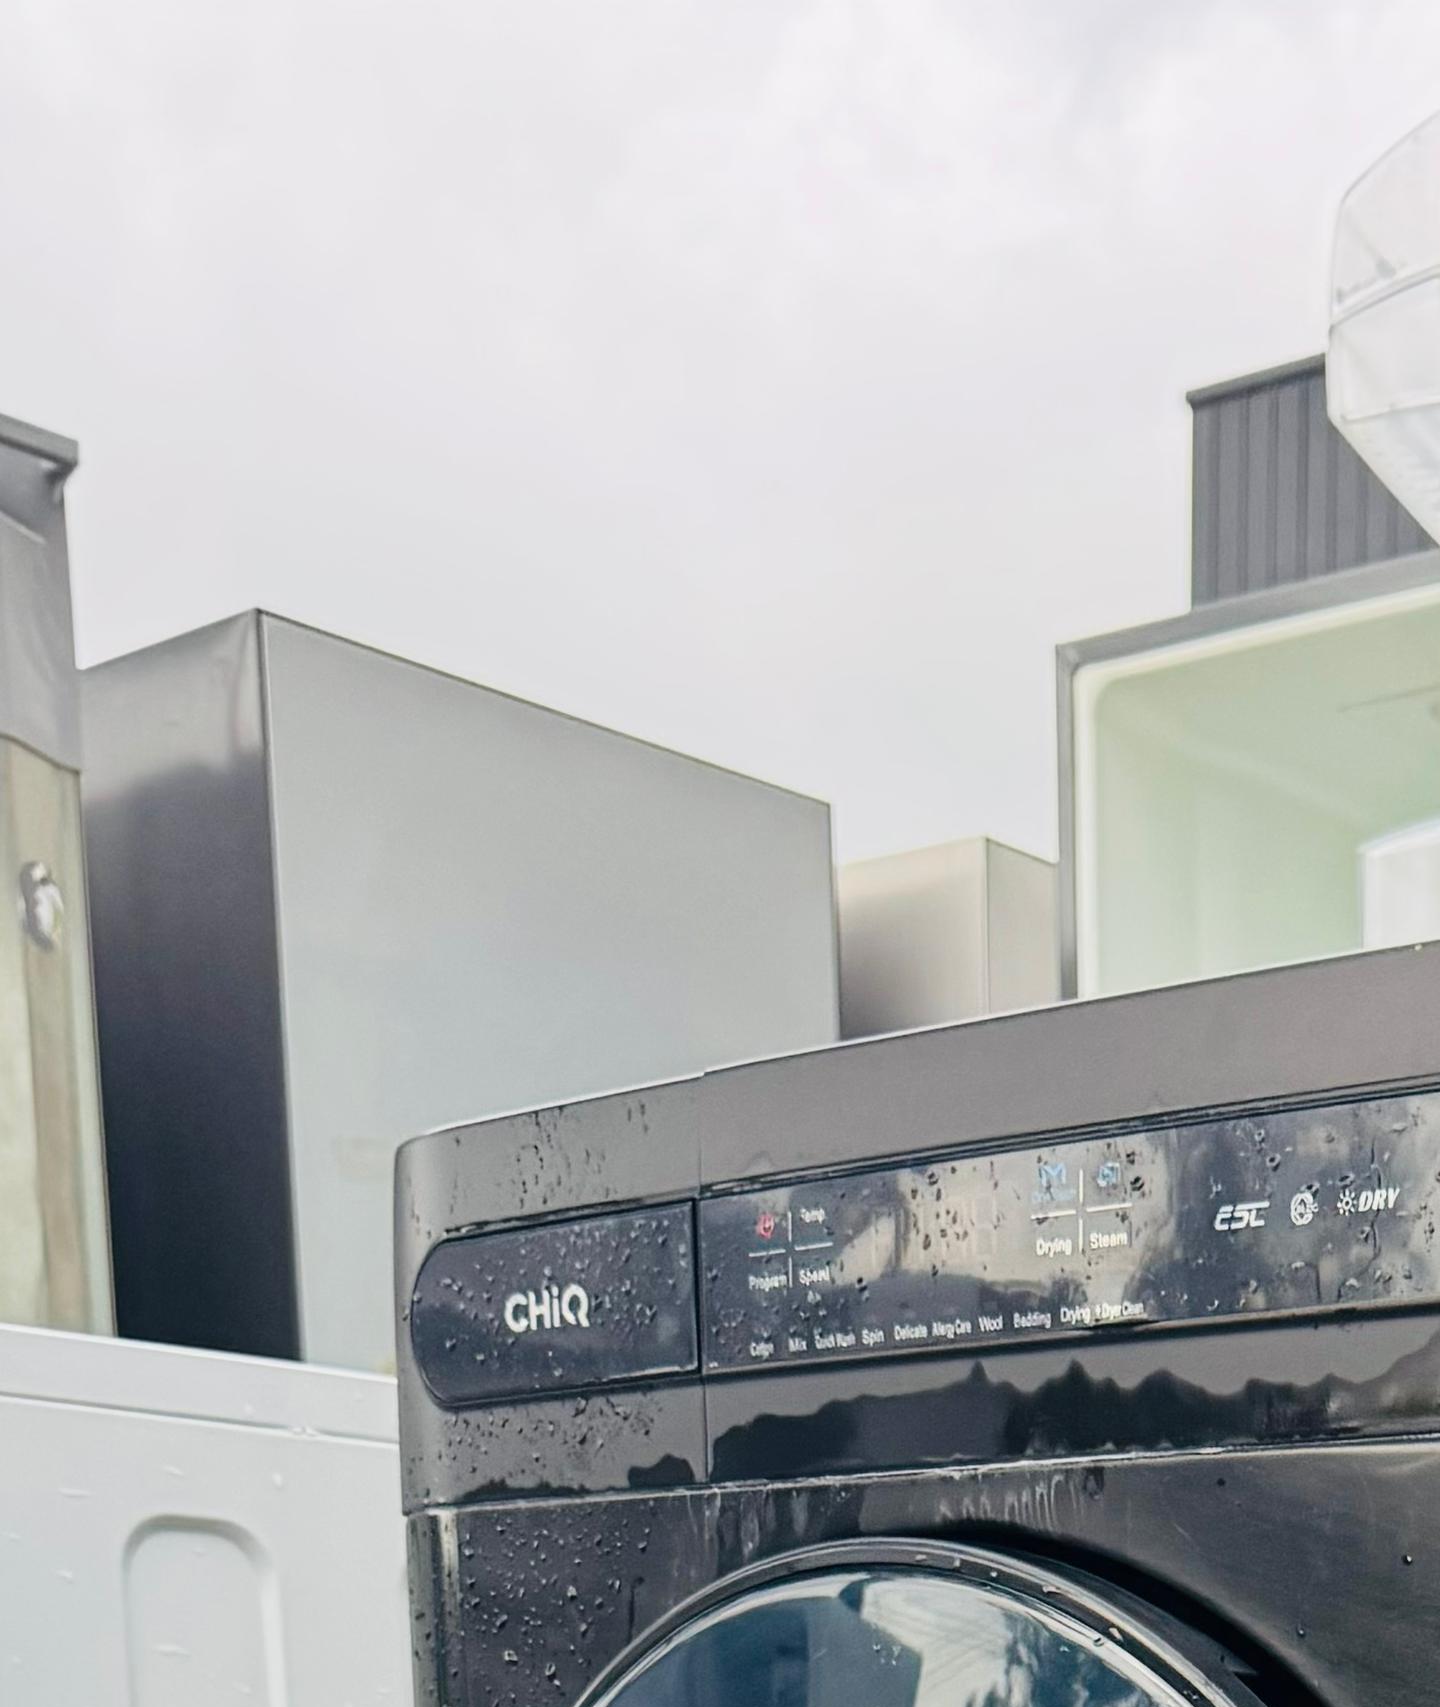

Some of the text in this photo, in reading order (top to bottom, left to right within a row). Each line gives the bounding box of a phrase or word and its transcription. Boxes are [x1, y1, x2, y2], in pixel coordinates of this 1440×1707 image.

[1358, 1188, 1401, 1212] DRY
[1035, 1236, 1073, 1258] Drying
[1089, 1231, 1128, 1249] Steam
[504, 1283, 590, 1333] CHiQ
[978, 1315, 1003, 1332] Wool
[861, 1329, 885, 1347] Spin
